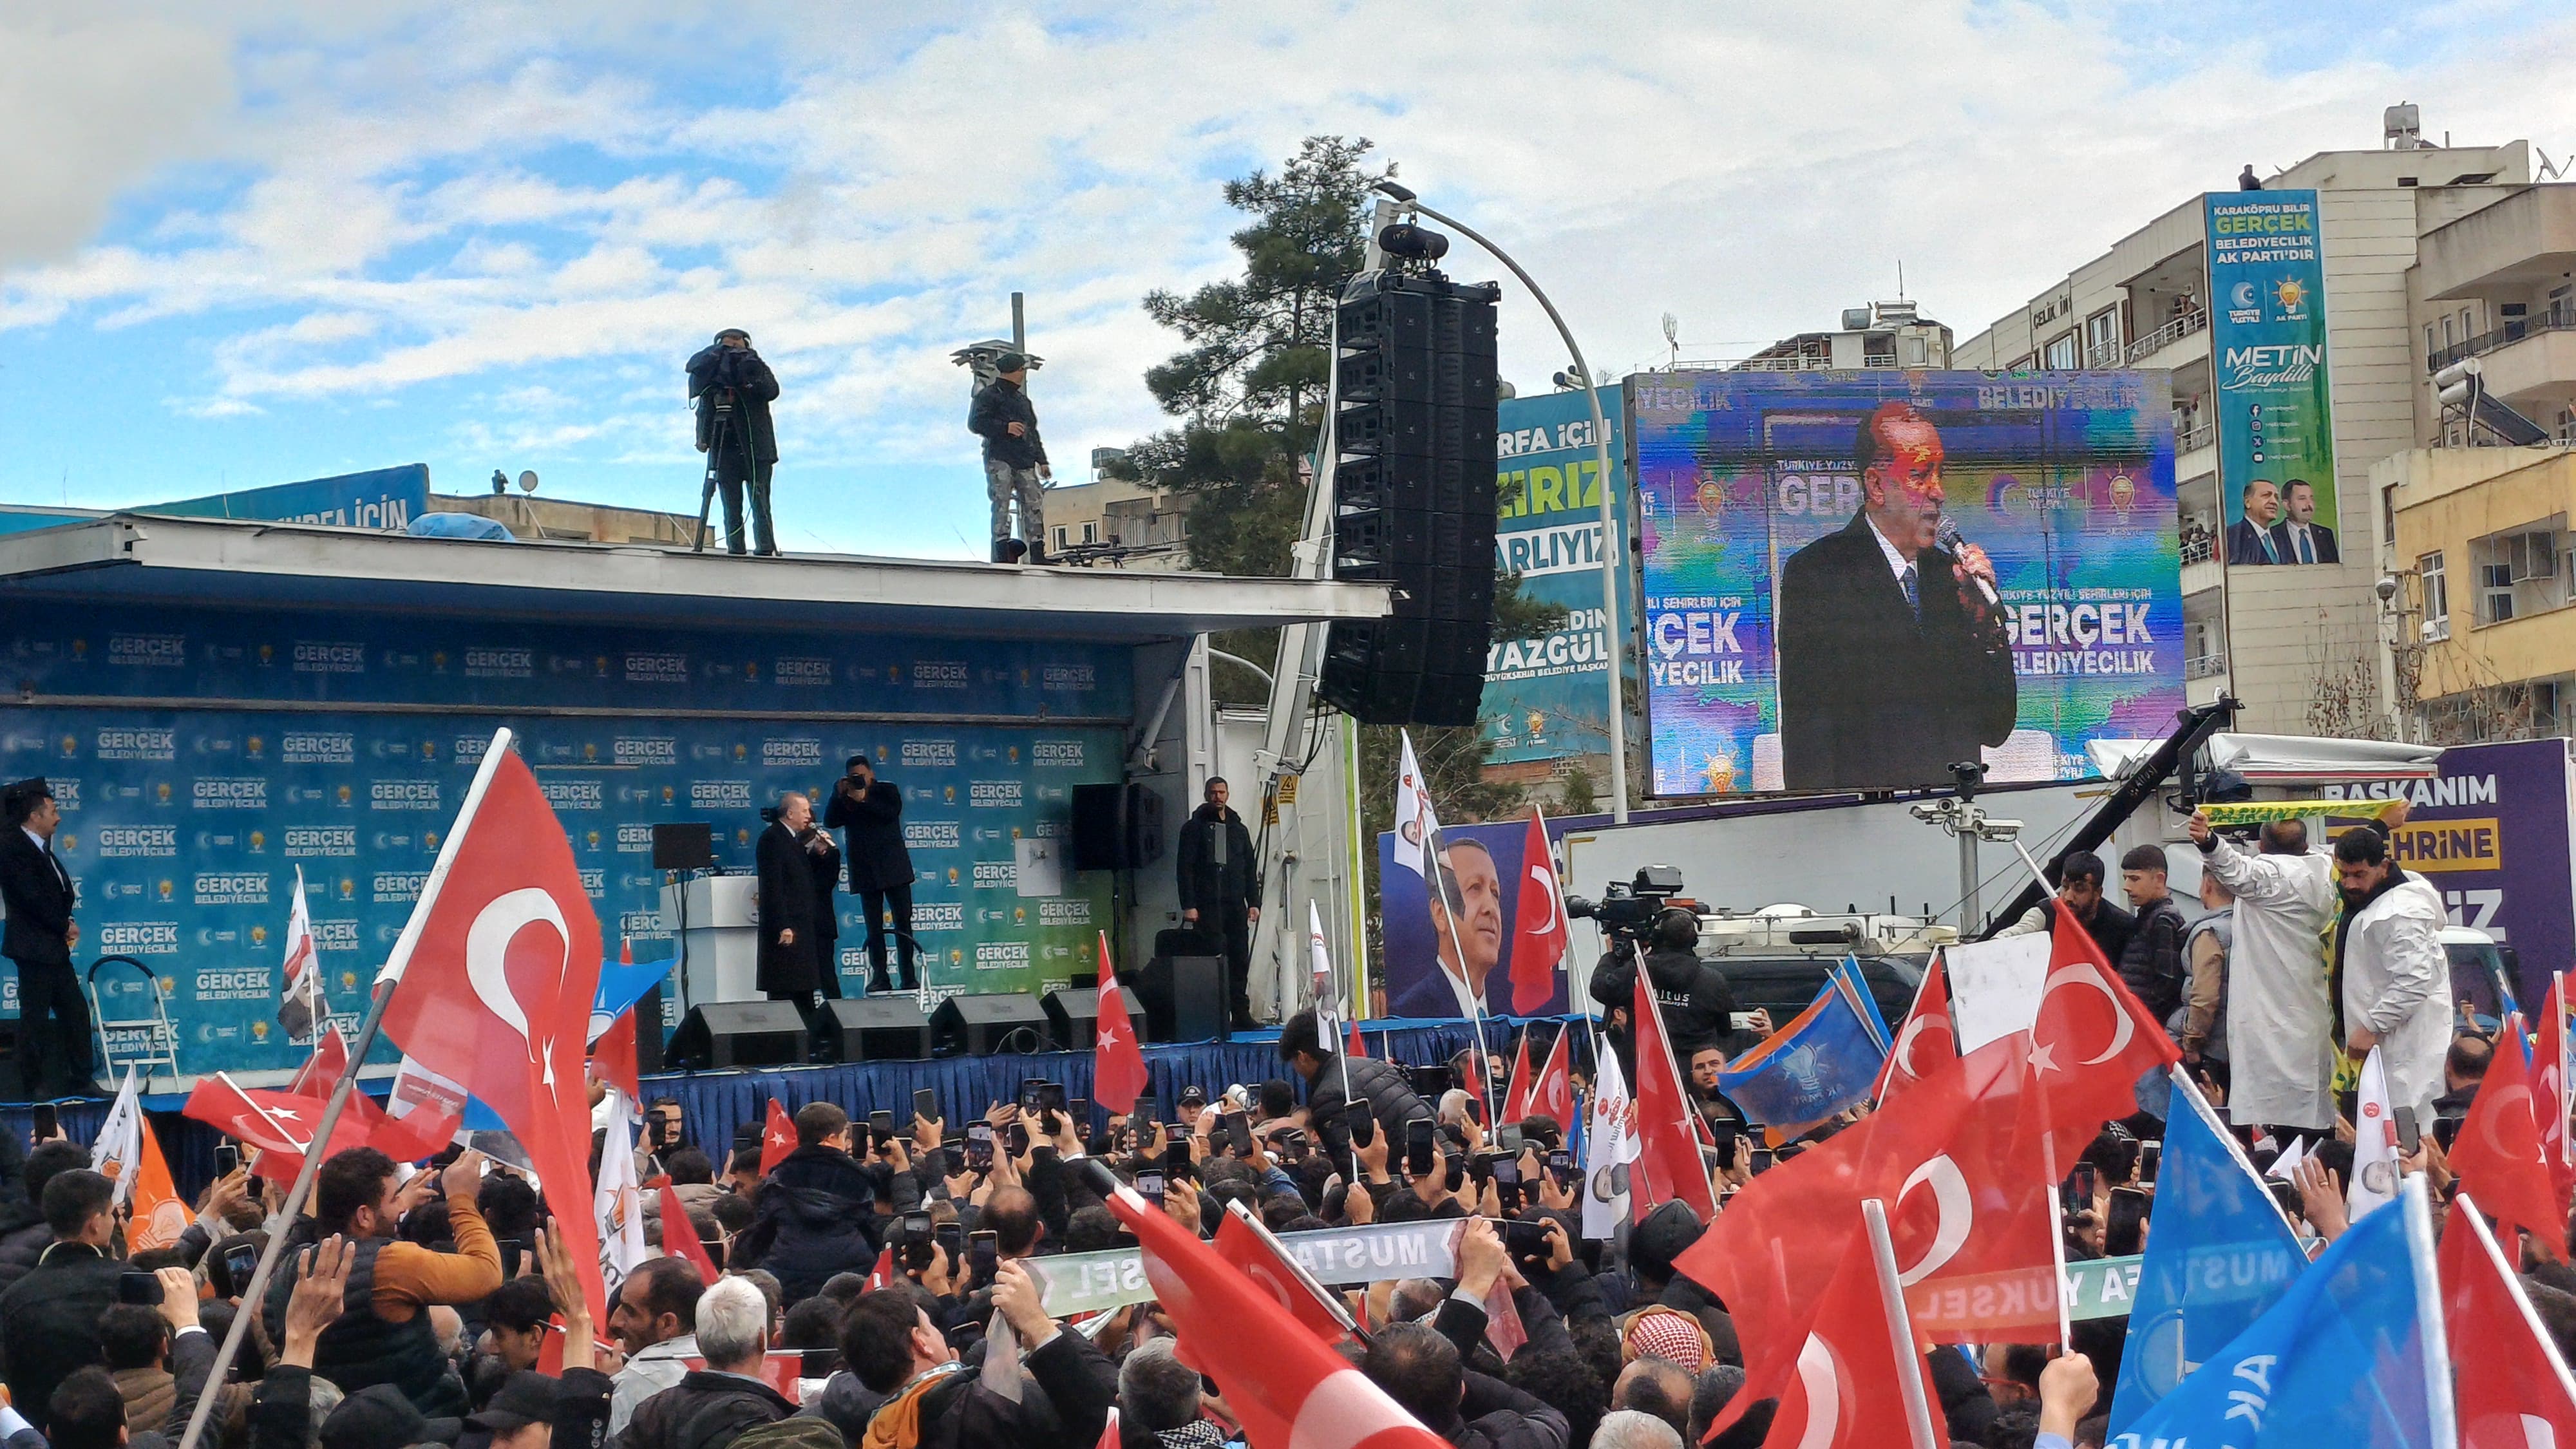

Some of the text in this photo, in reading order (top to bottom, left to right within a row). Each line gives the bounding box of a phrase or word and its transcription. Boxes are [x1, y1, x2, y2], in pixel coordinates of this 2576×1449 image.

[2215, 214, 2311, 234] GERÇEK
[2217, 252, 2239, 264] AK
[2225, 344, 2324, 368] METİN
[2222, 364, 2315, 391] Baydilli
[1557, 419, 1611, 449] İÇİN
[1562, 608, 1607, 632] DİN
[1648, 612, 1743, 659] ÇEK
[98, 732, 174, 750] GERÇEK
[283, 737, 352, 753] GERÇEK
[614, 741, 676, 757] GERÇEK
[762, 742, 820, 758] GERÇEK
[902, 744, 954, 759] GERÇEK
[1033, 744, 1083, 759] GERÇEK
[194, 781, 265, 799] GERÇEK
[371, 784, 439, 801] GERÇEK
[692, 784, 750, 801] GERÇEK
[970, 784, 1022, 800] GERÇEK
[100, 829, 176, 846] GERÇEK
[285, 830, 355, 847] GERÇEK
[905, 825, 958, 841] GERÇEK
[973, 866, 1016, 881] GERÇE
[195, 876, 268, 894] GERÇEK
[1039, 903, 1089, 920] GERÇEK
[101, 927, 177, 944] GERÇEK
[311, 925, 358, 942] RÇEK
[976, 947, 1028, 962] GERÇEK
[196, 973, 269, 990] GERÇEK
